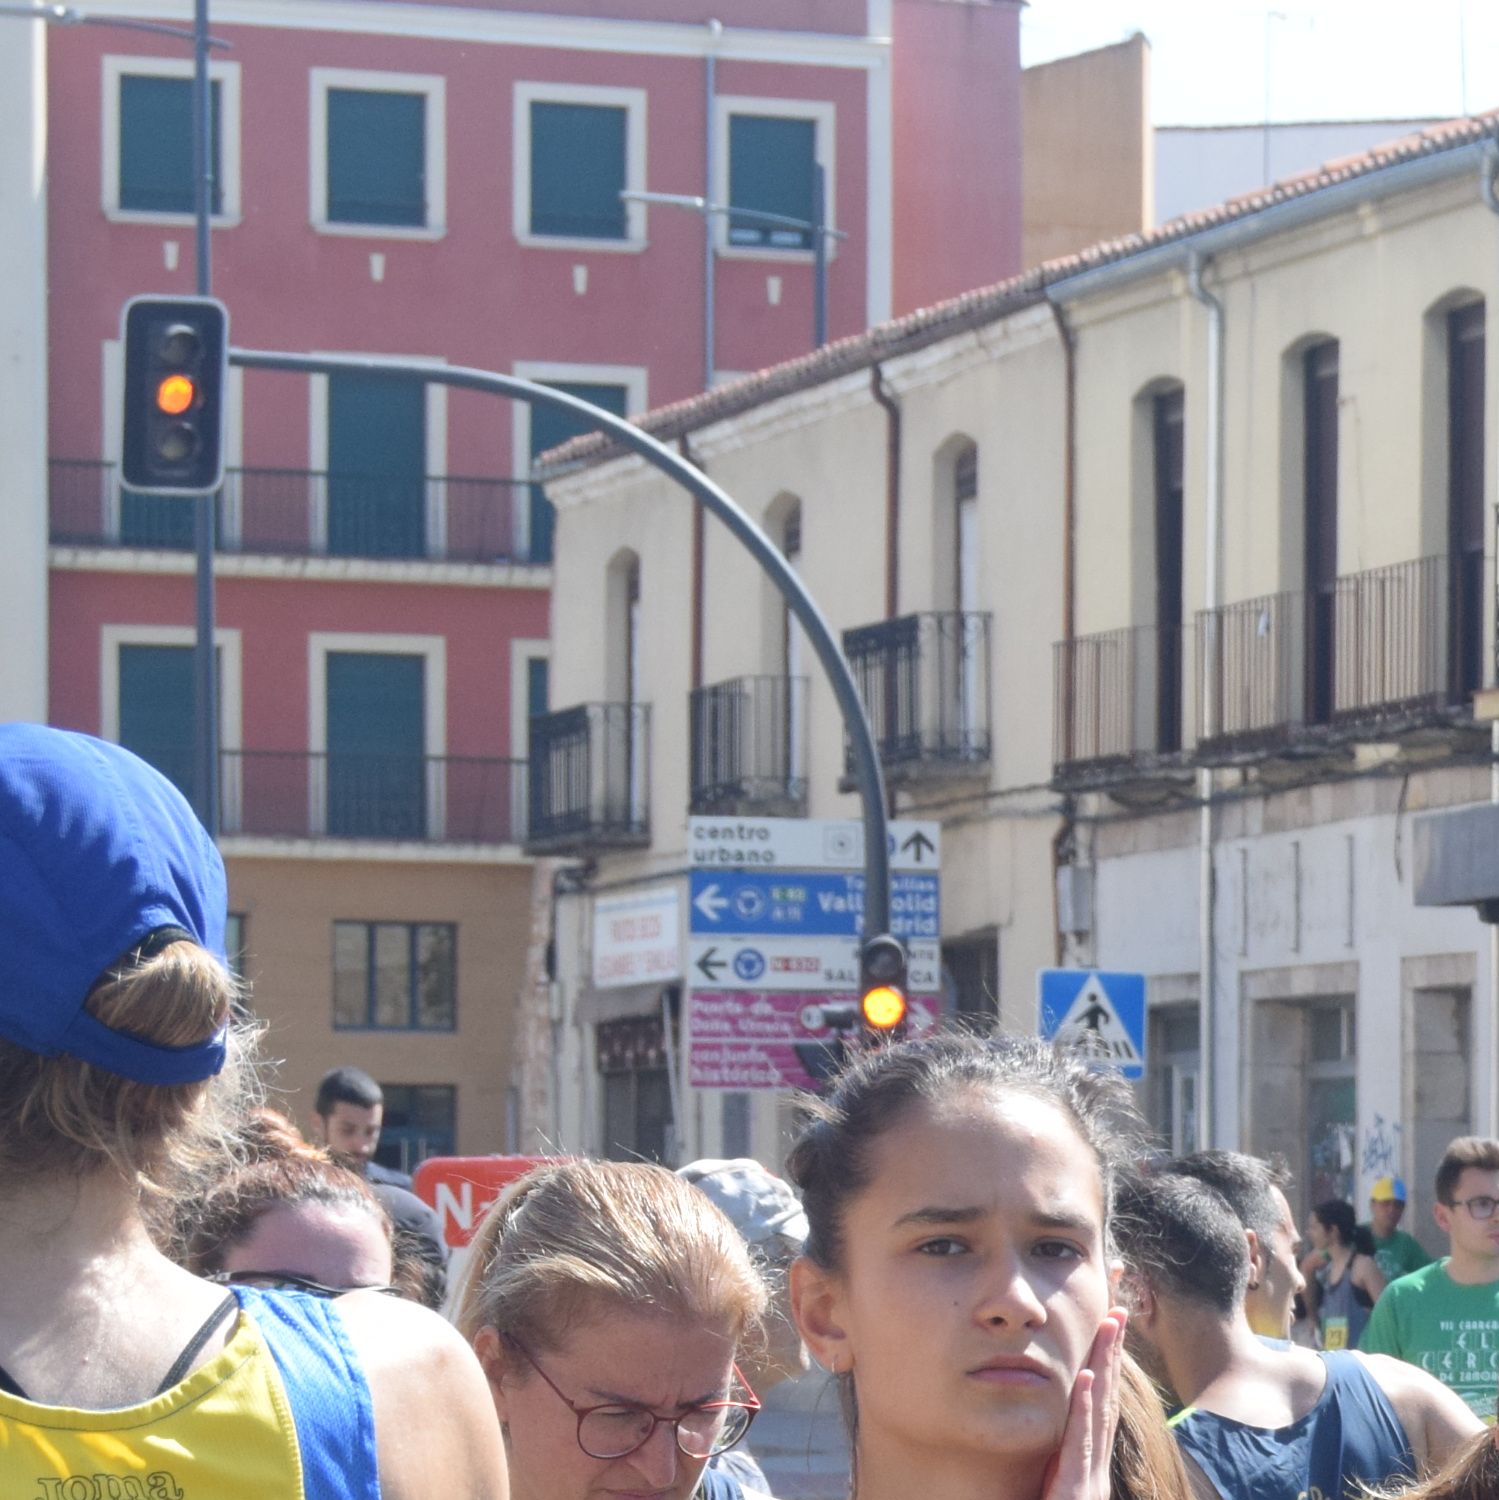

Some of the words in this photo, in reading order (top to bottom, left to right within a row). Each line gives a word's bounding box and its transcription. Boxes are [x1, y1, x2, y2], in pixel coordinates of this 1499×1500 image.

[693, 824, 771, 841] centro
[693, 848, 776, 863] urbano
[817, 892, 935, 914] Vallolid
[1421, 1351, 1499, 1370] CERC
[1459, 1371, 1499, 1382] ZAMOR
